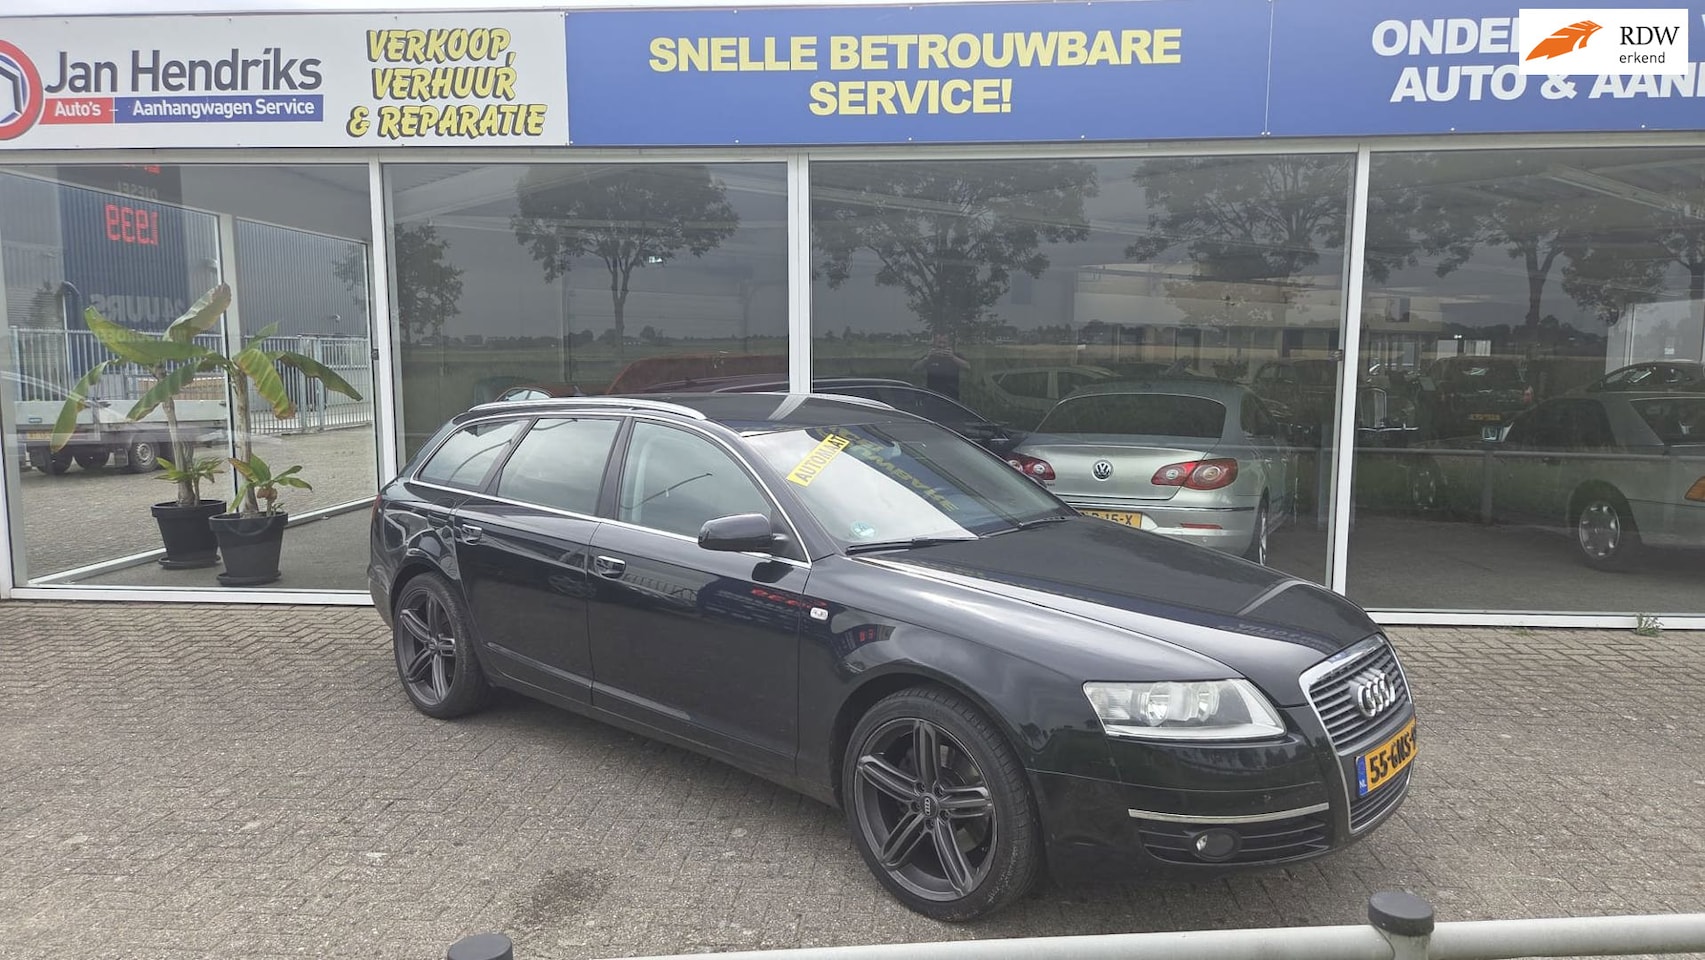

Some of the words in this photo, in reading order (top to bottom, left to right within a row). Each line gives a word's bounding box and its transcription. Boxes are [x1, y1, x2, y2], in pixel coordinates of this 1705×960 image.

[367, 28, 516, 66] VERKOOP,
[649, 36, 818, 72] SNELLE
[830, 28, 1182, 70] BETROUWBARE
[44, 51, 117, 93] Jan
[372, 66, 517, 100] VERHUUR
[1390, 65, 1527, 102] AUTO
[1540, 75, 1578, 100] &
[1588, 62, 1705, 98] AAN
[54, 99, 101, 117] Auto's
[133, 98, 253, 119] Aanhangwagen
[256, 97, 314, 115] Service
[808, 78, 1012, 116] SERVICE!
[346, 106, 370, 137] &
[378, 104, 548, 138] REPARATIE
[794, 435, 848, 482] AUTOMAAT
